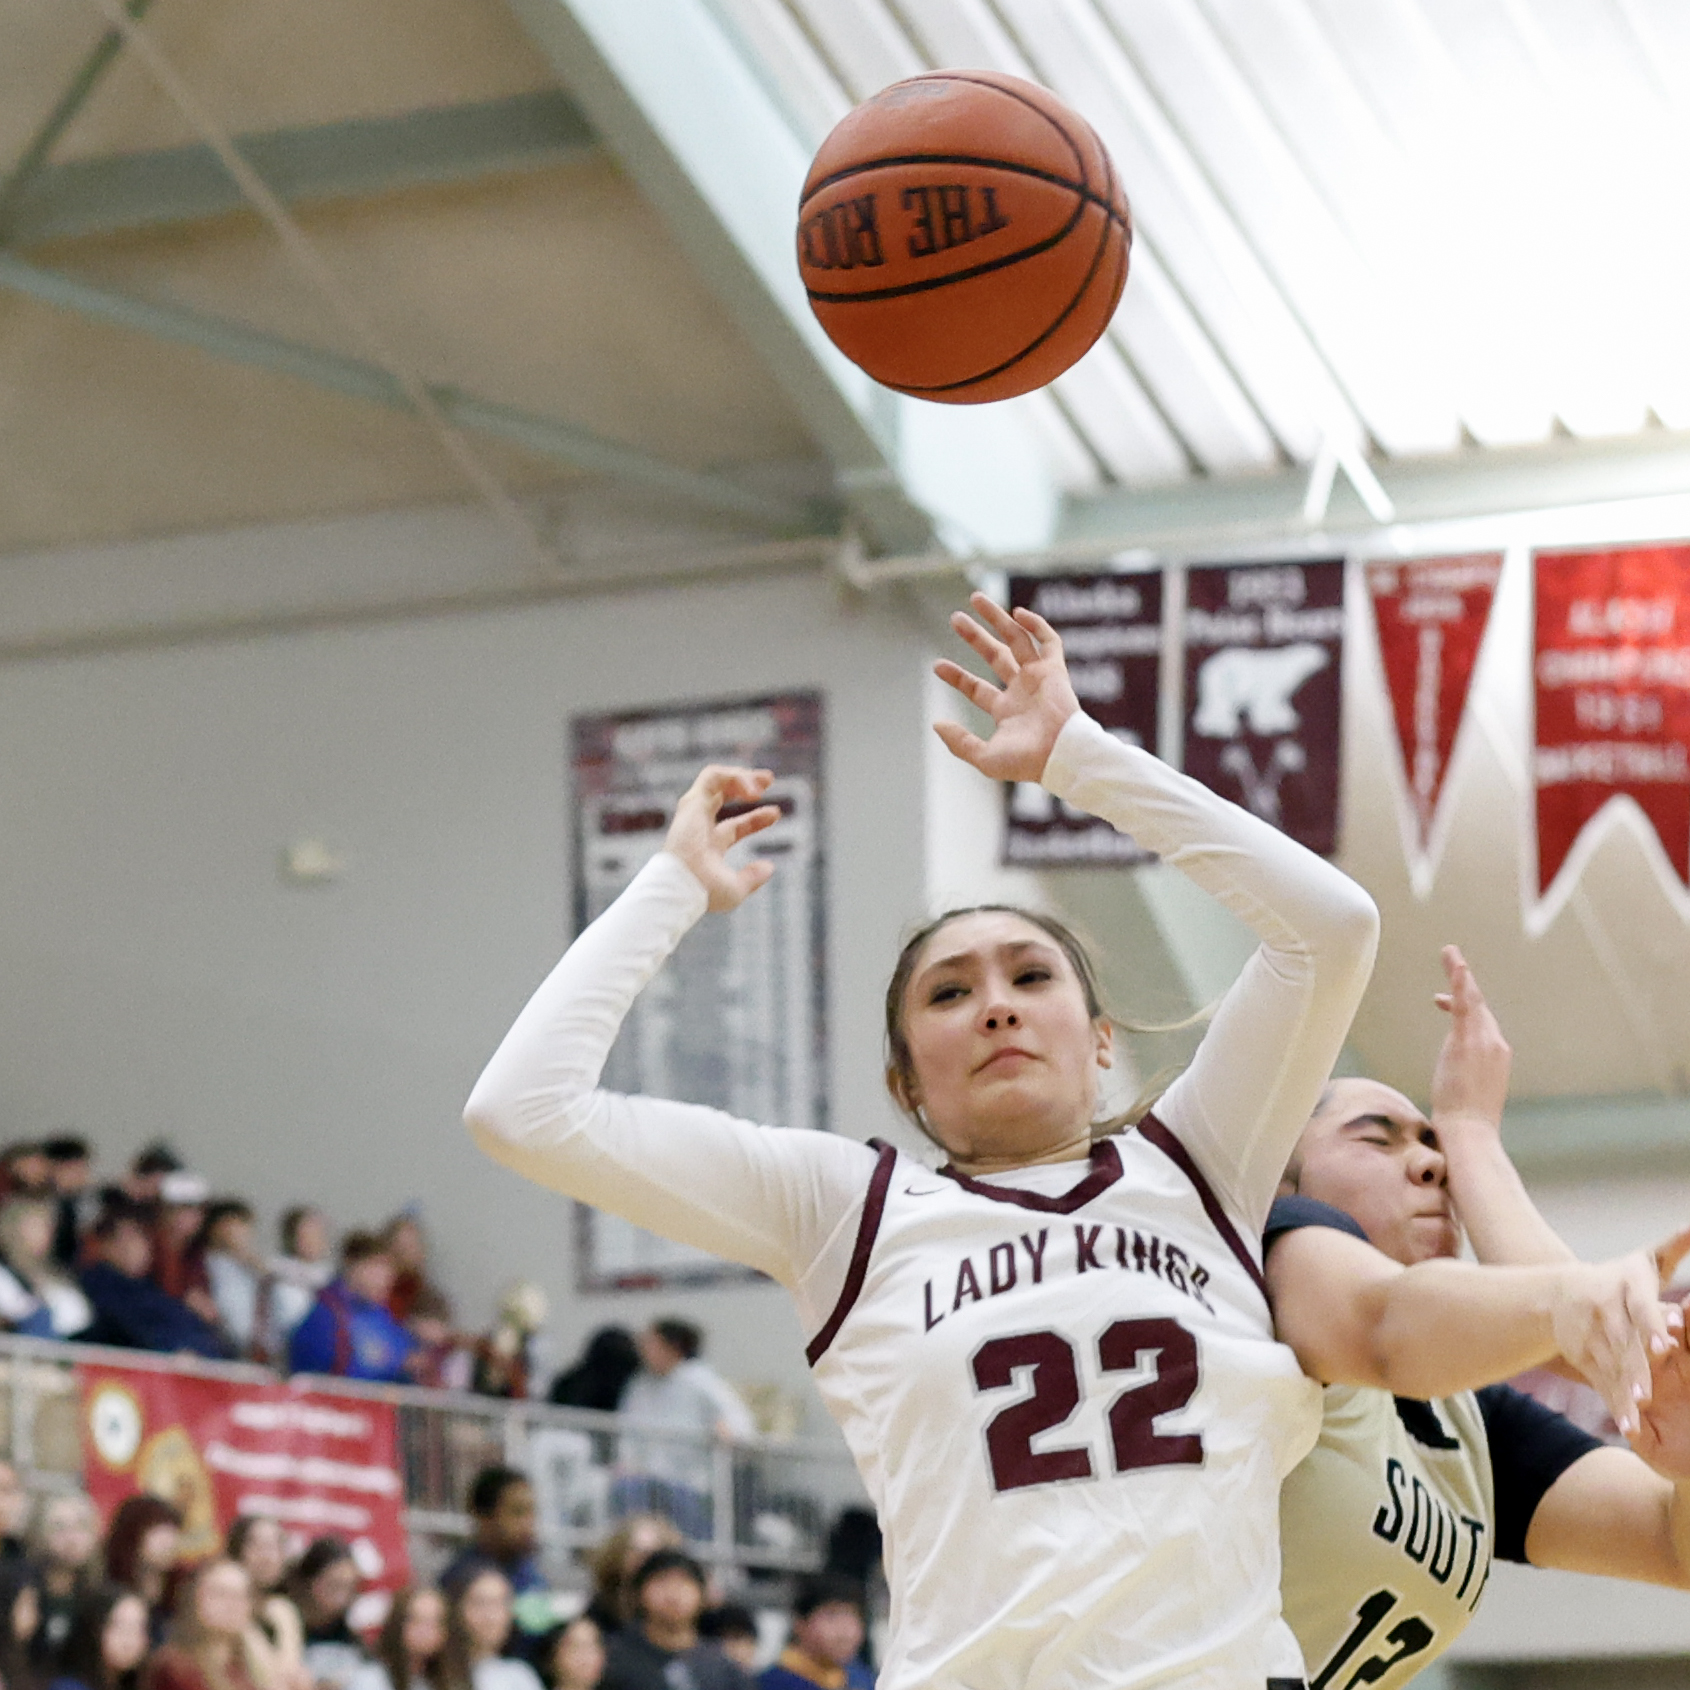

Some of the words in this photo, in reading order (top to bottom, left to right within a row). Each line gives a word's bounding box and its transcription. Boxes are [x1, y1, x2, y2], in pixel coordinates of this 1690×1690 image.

[903, 183, 1011, 259] THE
[923, 1228, 1050, 1334] LADY
[1074, 1223, 1217, 1318] KINGS
[967, 1315, 1206, 1493] 22
